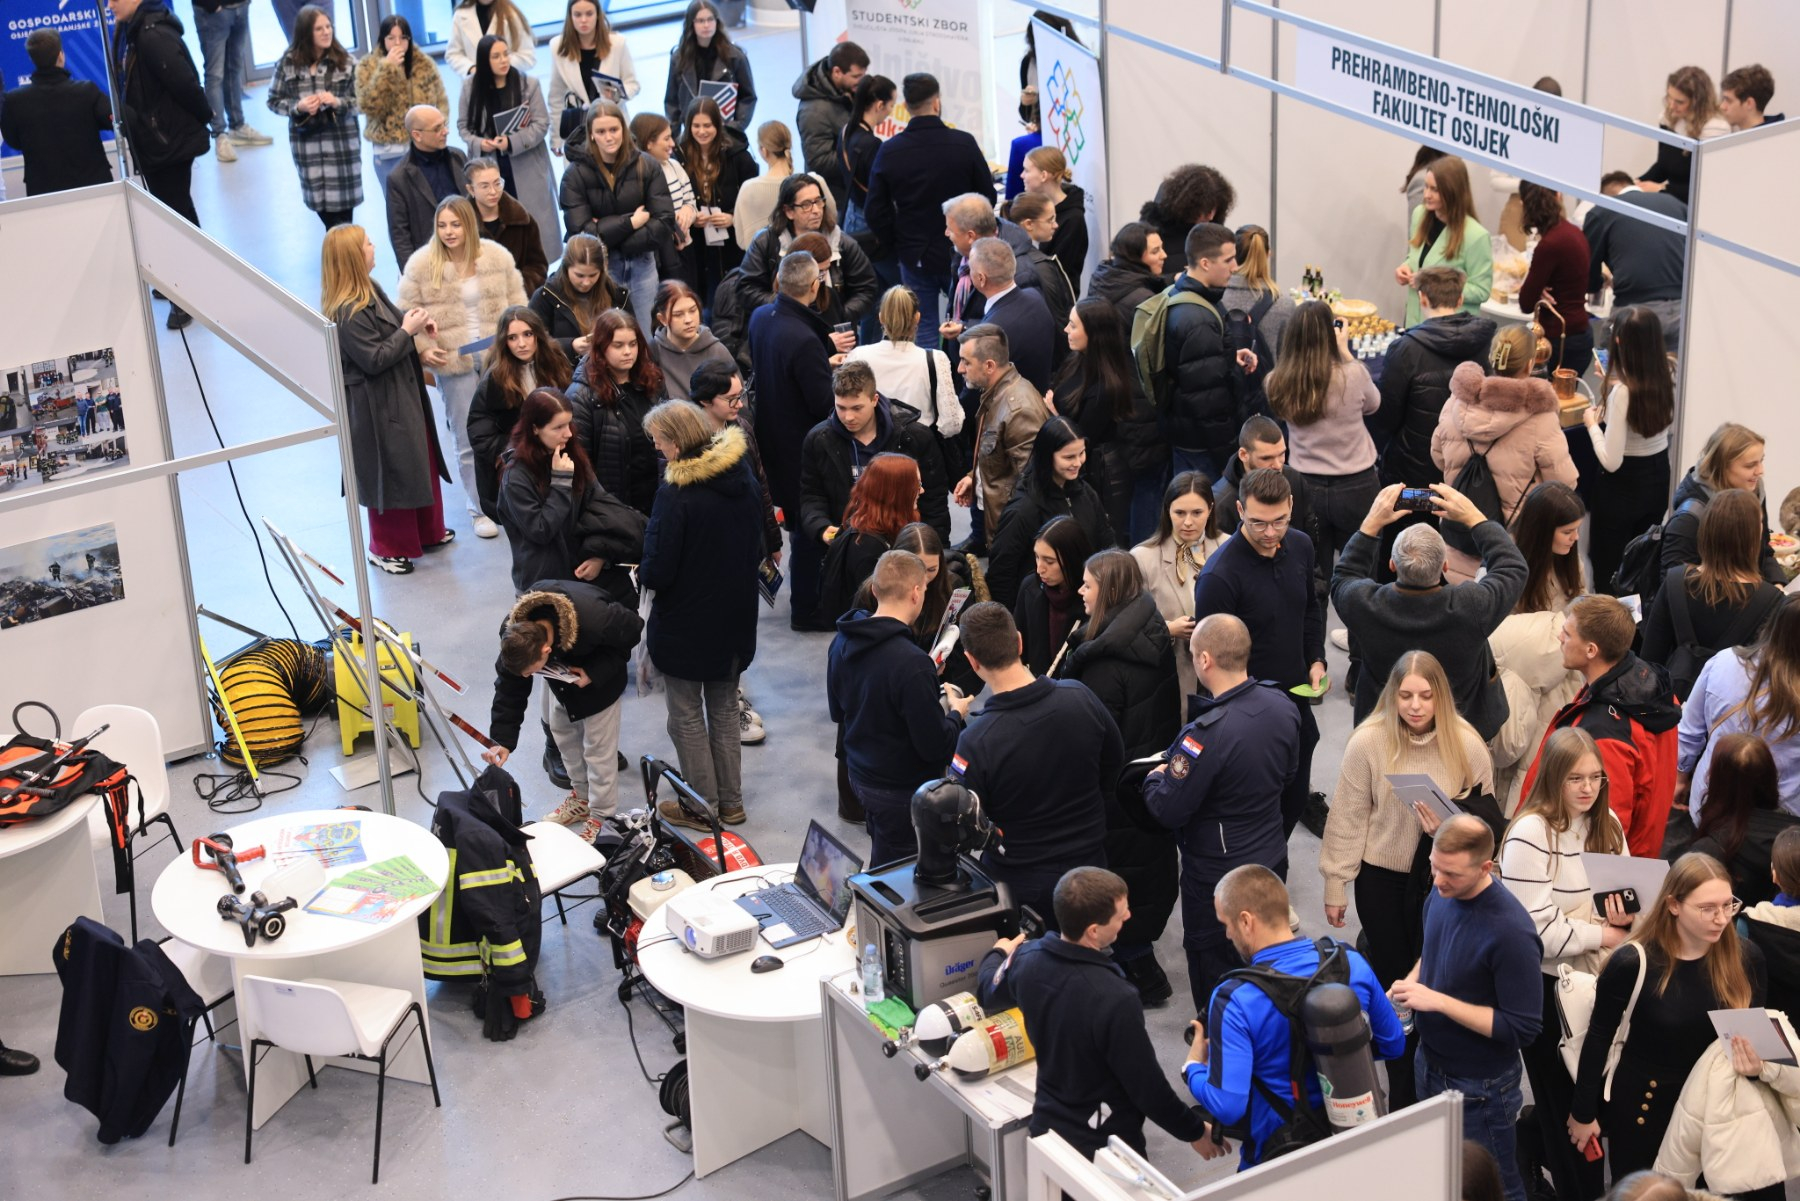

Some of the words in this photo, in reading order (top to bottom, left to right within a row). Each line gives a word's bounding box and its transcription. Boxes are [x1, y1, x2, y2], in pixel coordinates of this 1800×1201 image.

[8, 9, 96, 31] GOSPODARSKI
[851, 10, 930, 28] STUDENTSKI
[933, 18, 968, 33] ZBOR
[1331, 46, 1560, 143] PREHRAMBENO-TEHNOLOŠKI
[1373, 90, 1447, 137] FAKULTET
[1451, 116, 1510, 159] OSIJEK
[1332, 1096, 1371, 1108] Honeywell
